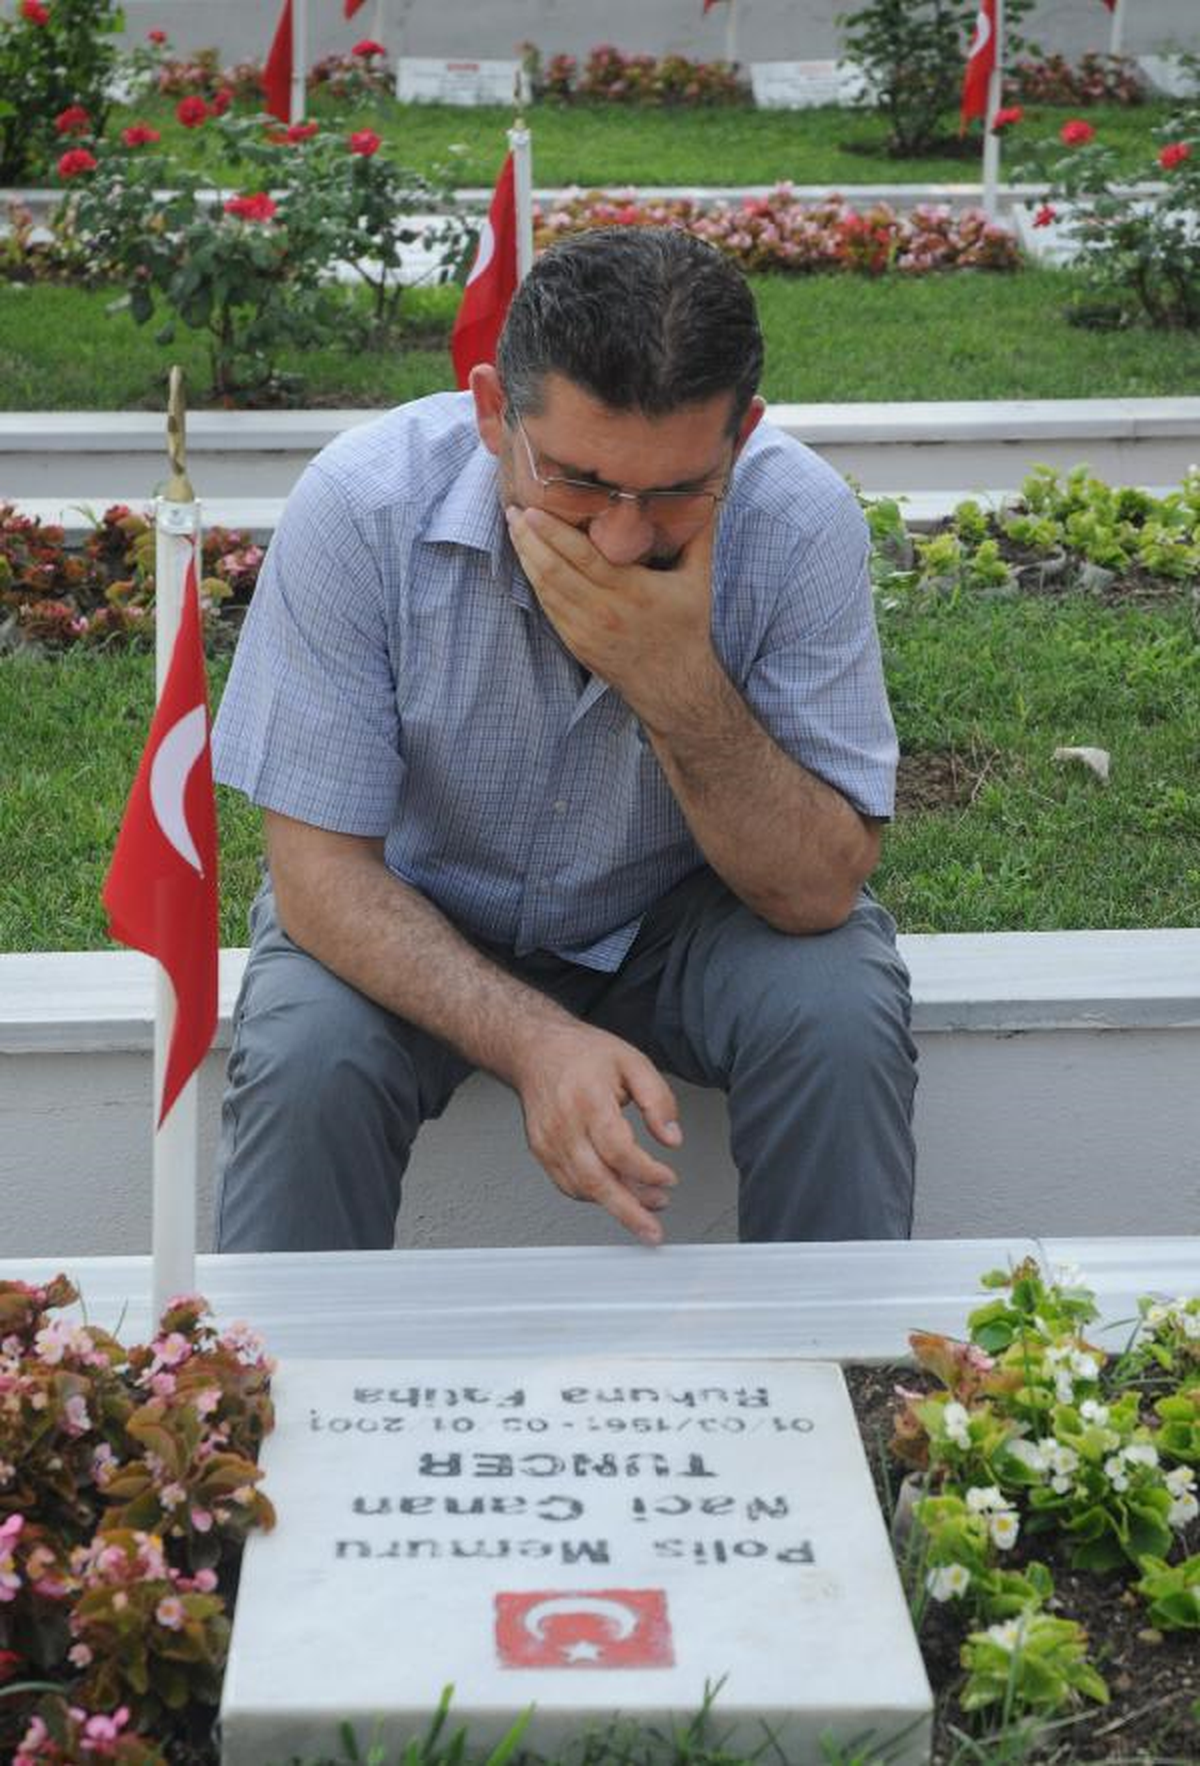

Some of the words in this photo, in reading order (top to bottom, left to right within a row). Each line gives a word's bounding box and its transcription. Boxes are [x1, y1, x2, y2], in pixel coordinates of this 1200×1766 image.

[353, 1387, 525, 1407] Fatiha
[561, 1387, 769, 1407] Ruhuna
[418, 1452, 719, 1476] TUNCER
[352, 1495, 584, 1520] Canan
[632, 1495, 789, 1520] Naci
[335, 1539, 611, 1564] Memuru
[653, 1539, 816, 1564] Polis
